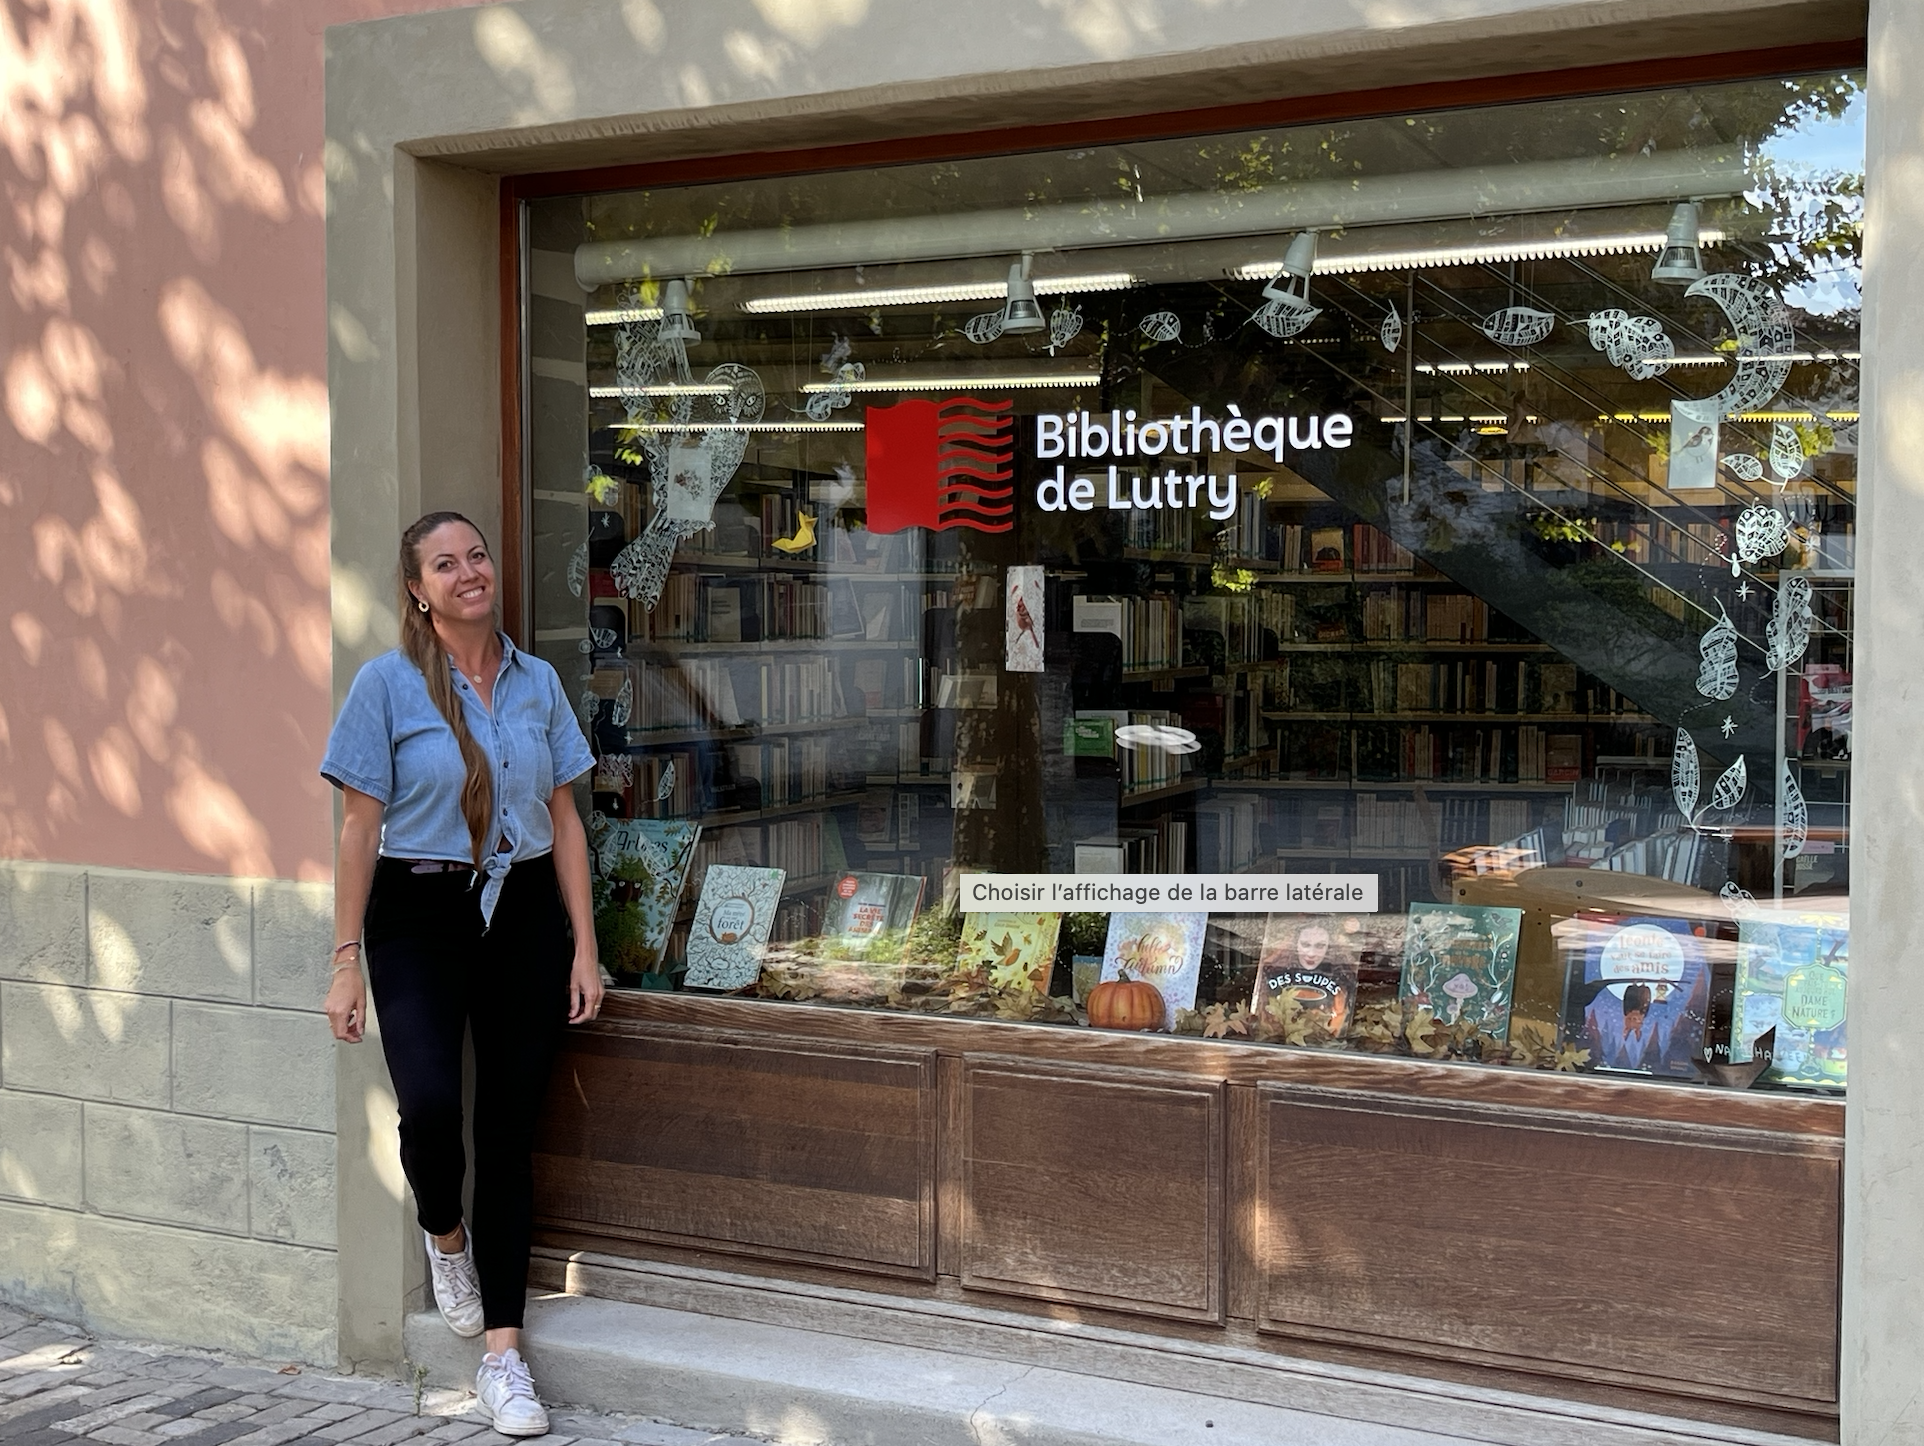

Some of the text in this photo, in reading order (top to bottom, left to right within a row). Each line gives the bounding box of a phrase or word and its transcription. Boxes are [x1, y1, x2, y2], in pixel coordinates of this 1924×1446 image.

[1036, 404, 1354, 463] Bibliothèque
[1036, 465, 1238, 520] de Lutry
[717, 916, 745, 931] forêt
[1613, 961, 1670, 975] des amis
[1268, 973, 1292, 990] DES
[1801, 994, 1828, 1007] DAME
[1792, 1005, 1829, 1019] NATURE
